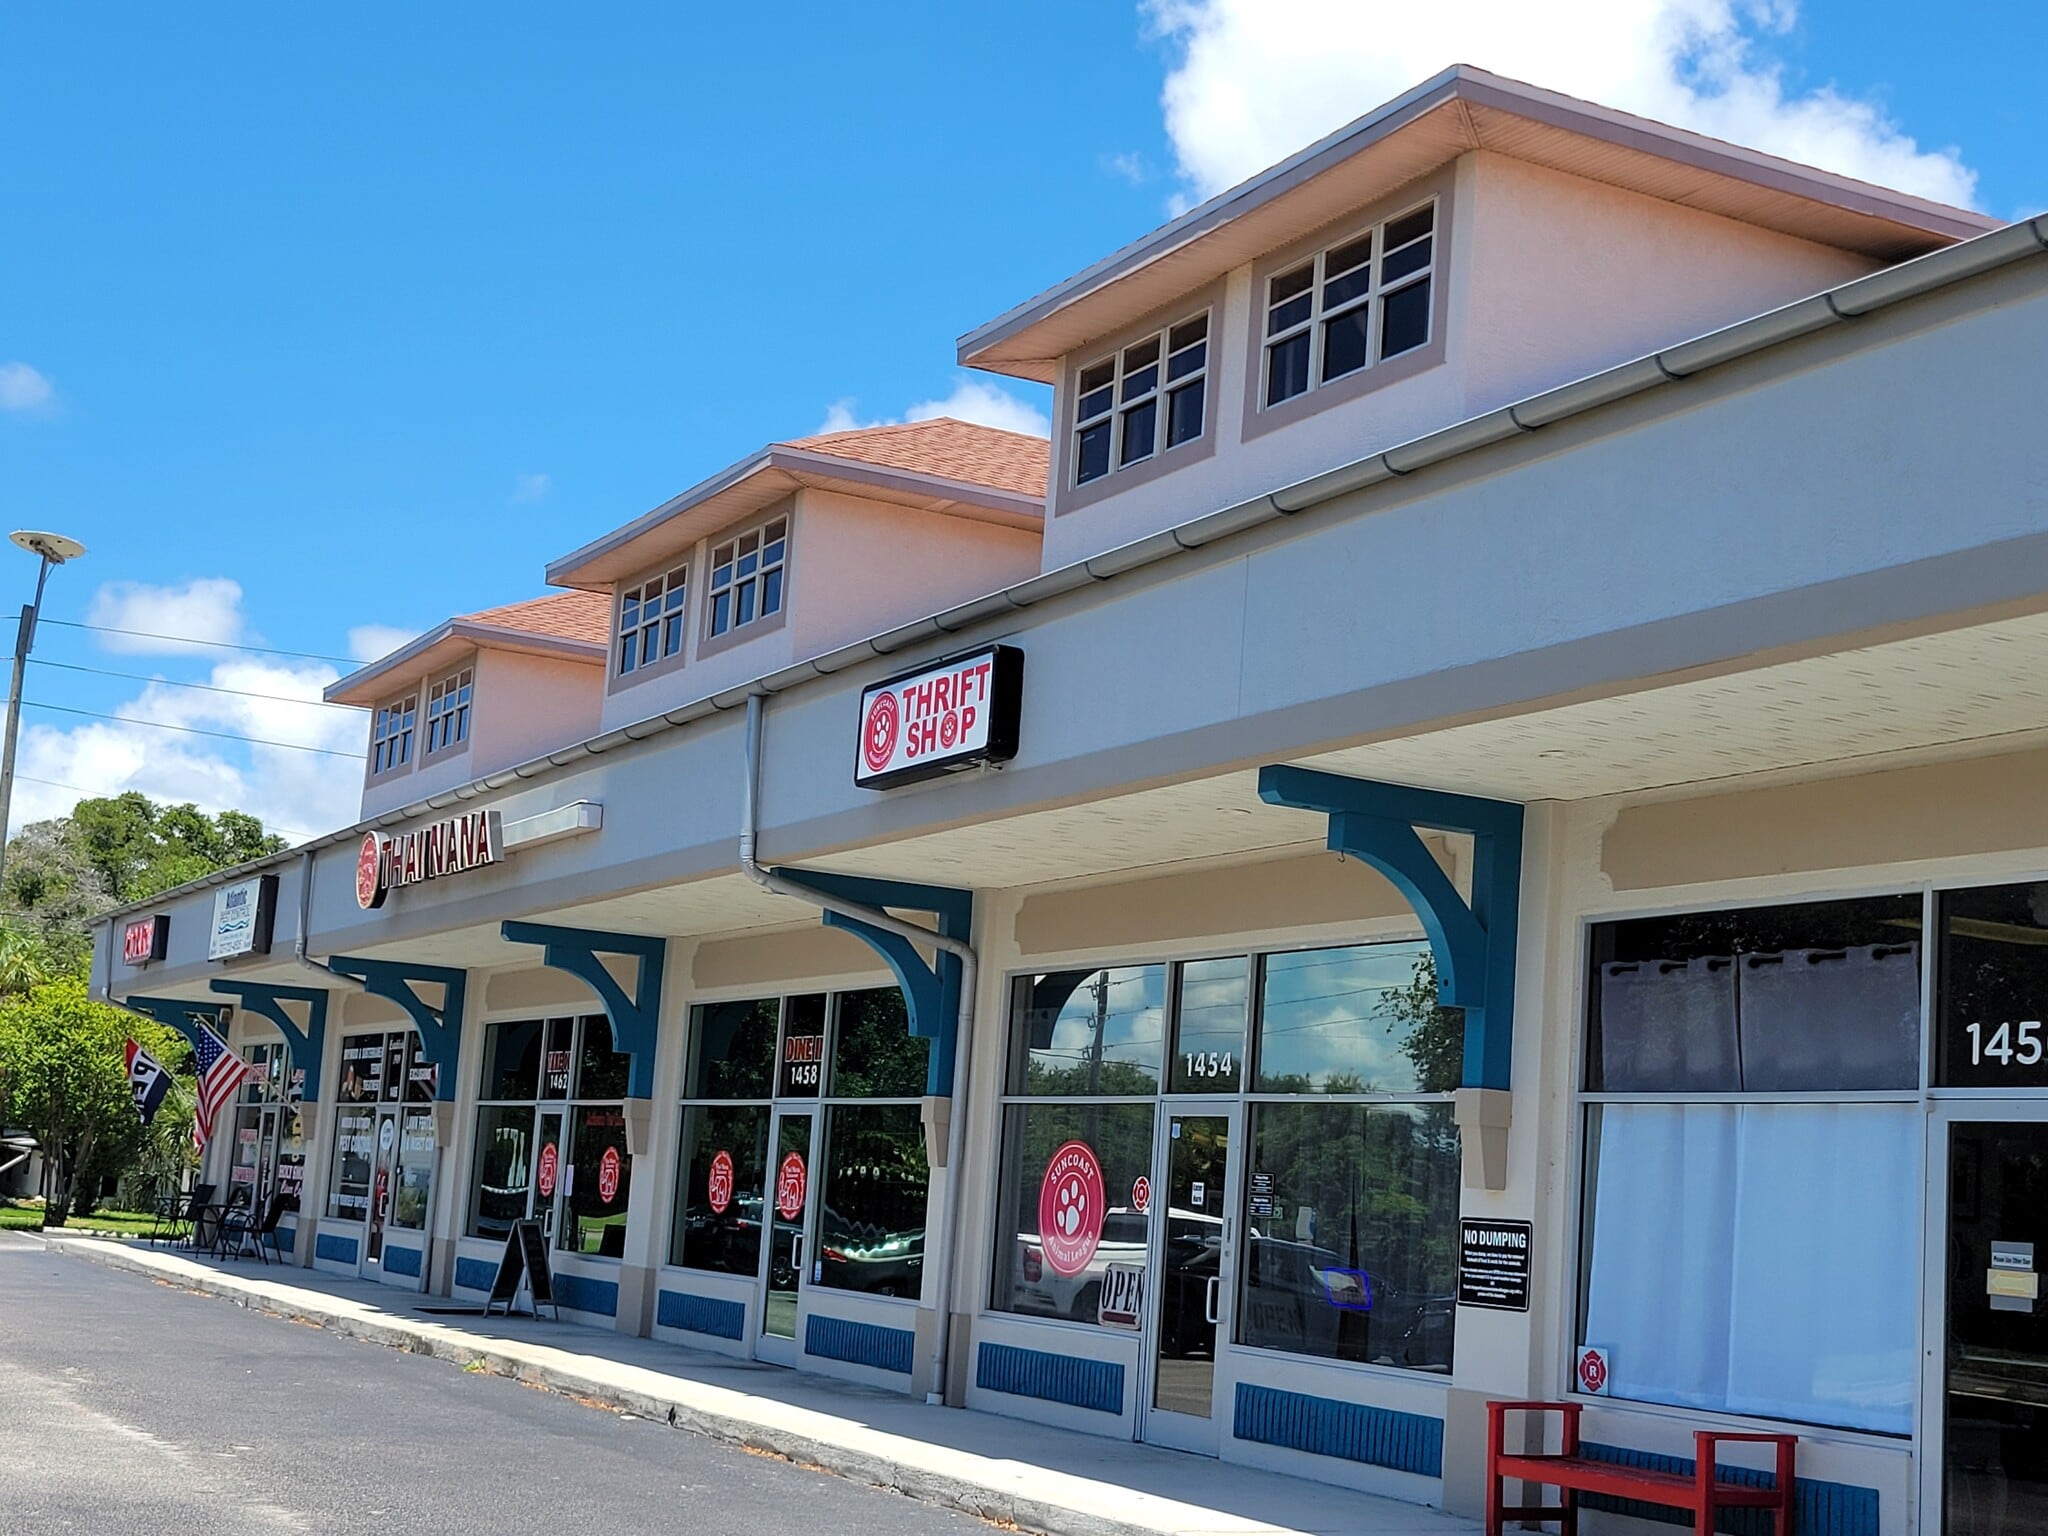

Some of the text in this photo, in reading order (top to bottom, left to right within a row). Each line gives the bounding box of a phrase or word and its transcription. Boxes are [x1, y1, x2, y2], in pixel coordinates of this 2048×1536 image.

[903, 663, 991, 723] THRIFT
[906, 706, 976, 758] SHOP
[382, 810, 494, 889] THAI NANA
[785, 1036, 814, 1062] DINE
[1966, 1021, 2048, 1065] 145
[791, 1065, 818, 1085] 1458
[1186, 1051, 1232, 1078] 1454
[550, 1073, 568, 1089] 1462
[1050, 1153, 1095, 1185] SUNCOAST
[1048, 1230, 1094, 1262] Animal League
[1464, 1229, 1527, 1248] NO DUMPING
[1102, 1269, 1145, 1314] OPEN
[1589, 1365, 1597, 1377] R
